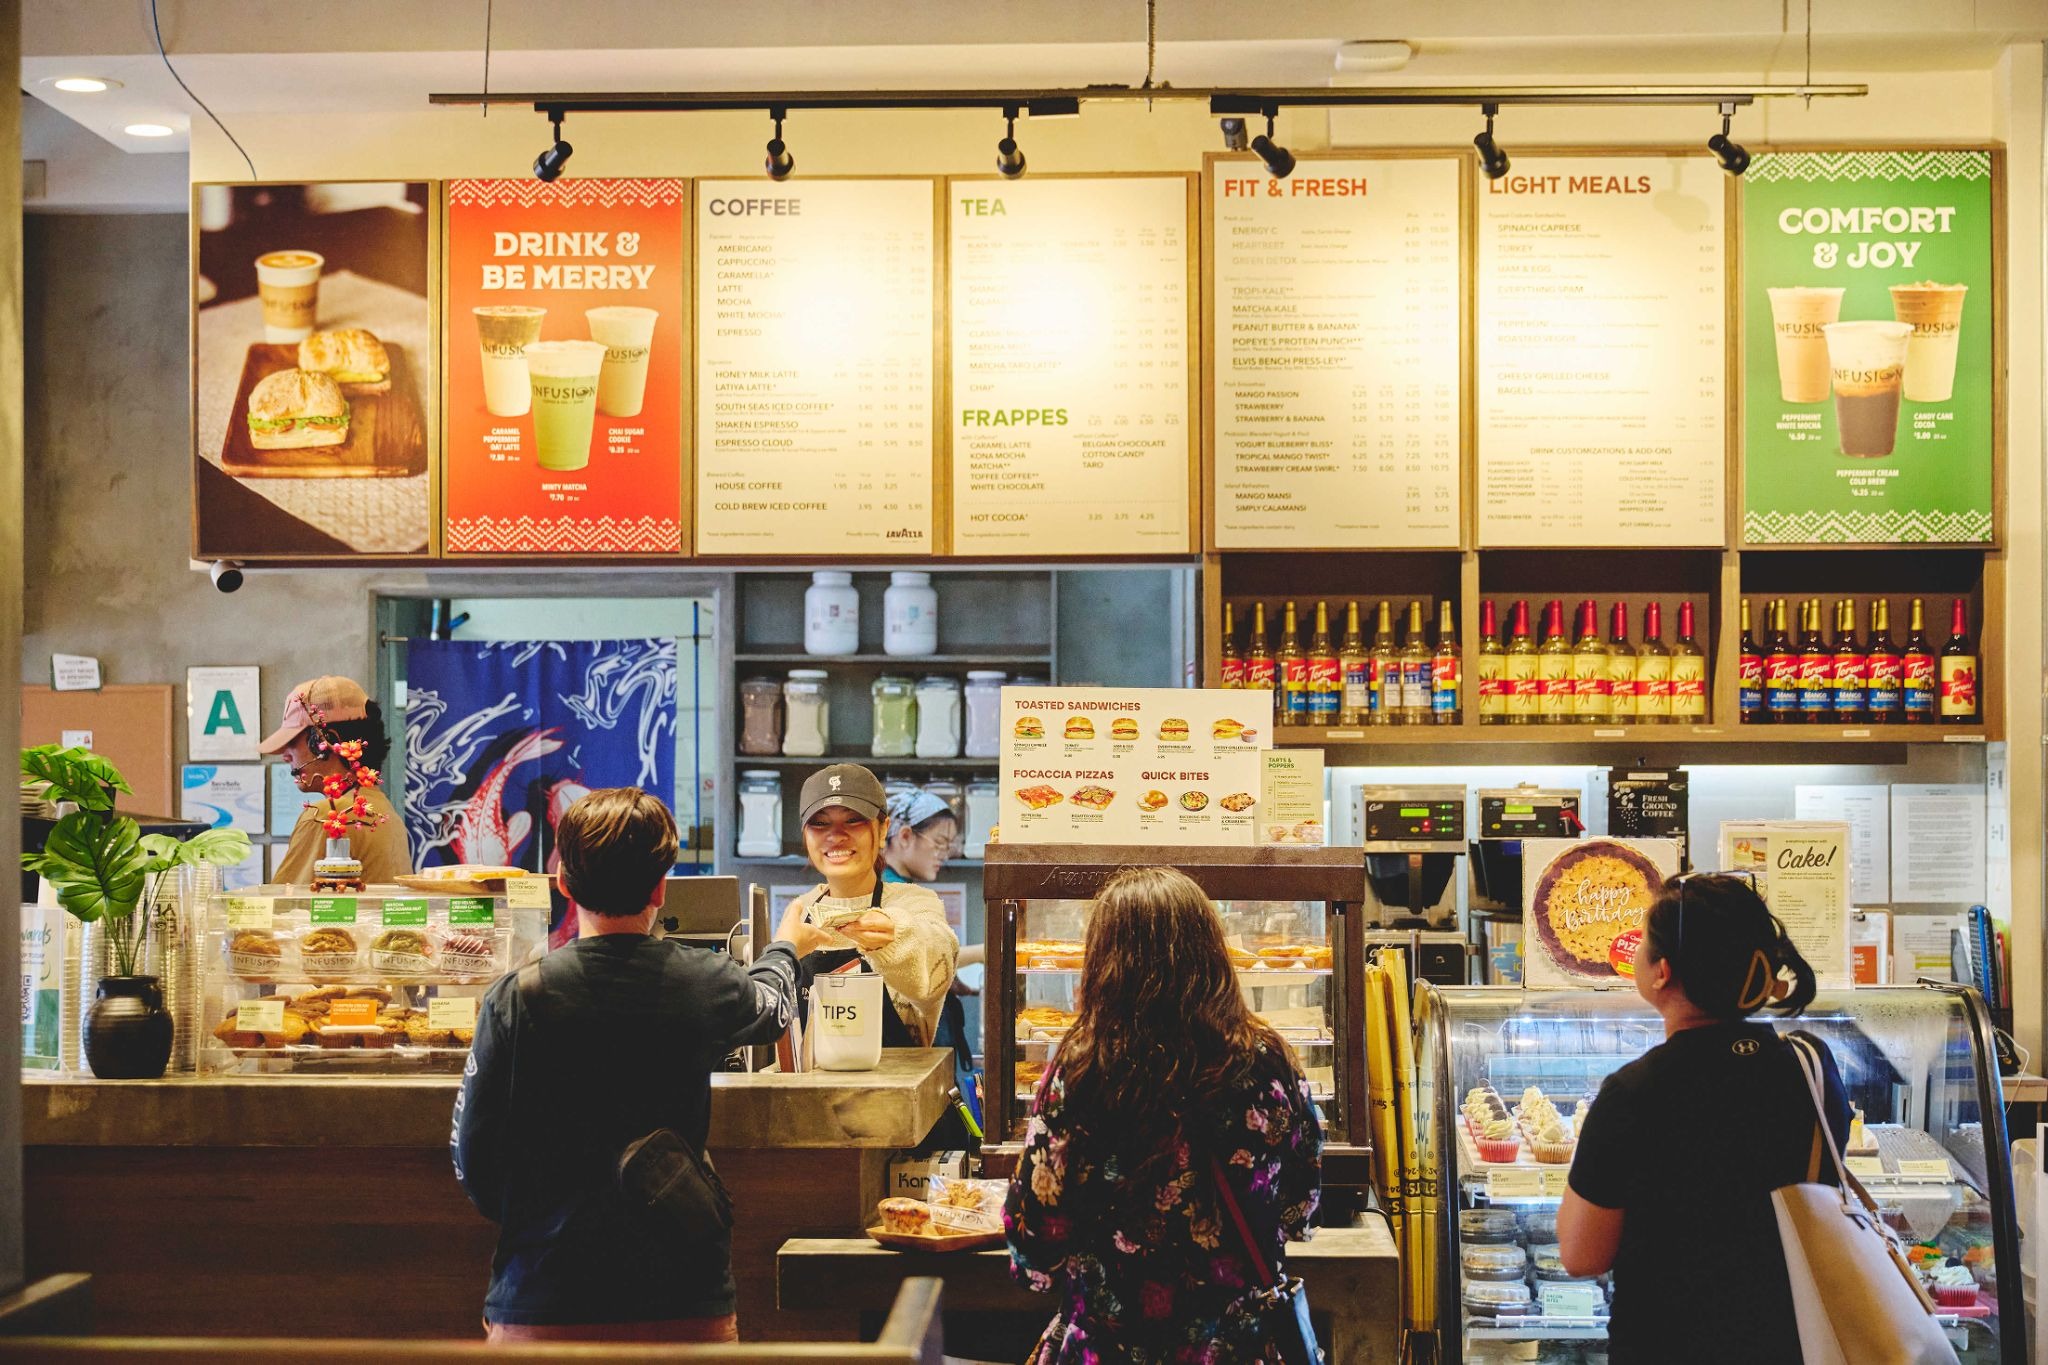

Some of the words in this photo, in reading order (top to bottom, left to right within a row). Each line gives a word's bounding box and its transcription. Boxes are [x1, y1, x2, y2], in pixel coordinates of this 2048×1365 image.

[1225, 179, 1260, 197] FIT
[1267, 179, 1282, 197] &
[1292, 178, 1367, 196] FRESH
[1489, 176, 1561, 194] LIGHT
[1569, 176, 1651, 194] MEALS
[709, 199, 801, 217] COFFEE
[961, 199, 1007, 217] TEA
[1778, 207, 1956, 234] COMFORT
[1232, 226, 1269, 235] ENERGY
[1271, 226, 1278, 235] C
[1498, 224, 1538, 233] SPINACH
[1540, 224, 1581, 233] CAPRESE
[494, 232, 608, 257] DRINK
[615, 232, 640, 257] &
[717, 244, 773, 253] AMERICANO
[1812, 242, 1839, 269] &
[1846, 241, 1921, 269] JOY
[717, 258, 776, 267] CAPPUCCINO
[1531, 265, 1551, 273] EGG
[481, 265, 526, 290] BE
[532, 265, 656, 290] MERRY
[717, 285, 743, 293] LATTE
[1498, 285, 1556, 294] EVERYTHING
[1558, 285, 1584, 294] SPAM
[717, 298, 752, 306] MOCHA
[1232, 305, 1297, 313] MATCHA-KALE
[717, 311, 746, 320] WHITE
[1232, 323, 1269, 332] PEANUT
[1271, 323, 1306, 332] BUTTER
[1308, 323, 1314, 332] &
[717, 328, 762, 337] ESPRESSO
[1232, 337, 1276, 346] POPEYE'S
[1278, 337, 1318, 346] PROTEIN
[1232, 357, 1257, 366] ELVIS
[1259, 357, 1290, 366] BENCH
[716, 371, 747, 379] HONEY
[749, 371, 771, 379] MILK
[773, 371, 799, 379] LATTE
[1498, 372, 1533, 381] CHEESY
[1535, 372, 1573, 381] GRILLED
[1575, 372, 1610, 381] CHEESE
[715, 384, 744, 392] LATIYA
[1498, 387, 1533, 395] BAGELS
[1235, 390, 1265, 398] MANGO
[1267, 390, 1300, 398] PASSION
[715, 403, 745, 411] SOUTH
[747, 403, 770, 411] SEAS
[772, 403, 793, 411] ICED
[1235, 403, 1284, 411] STRAWBERRY
[962, 408, 1069, 426] FRAPPES
[1235, 415, 1284, 423] STRAWBERRY
[1286, 415, 1292, 423] &
[1293, 415, 1325, 423] BANANA
[1913, 413, 1935, 421] CANDY
[1936, 413, 1953, 421] CANE
[715, 420, 752, 429] SHAKEN
[754, 420, 799, 429] ESPRESSO
[1776, 422, 1798, 430] WHITE
[1798, 422, 1822, 430] MOCHA
[1913, 421, 1936, 429] COCOA
[715, 438, 760, 447] ESPRESSO
[761, 438, 793, 447] CLOUD
[970, 441, 1007, 449] CARAMEL
[1009, 441, 1032, 449] LATTE
[1082, 440, 1116, 448] BELGIAN
[1117, 440, 1166, 448] CHOCOLATE
[1236, 440, 1265, 448] YOGURT
[1267, 440, 1308, 448] BLUEBERRY
[970, 451, 993, 459] KONA
[996, 451, 1026, 459] MOCHA
[1236, 452, 1271, 460] TROPICAL
[1273, 452, 1303, 460] MANGO
[1082, 461, 1104, 469] TARO
[1236, 465, 1284, 473] STRAWBERRY
[1286, 465, 1312, 473] CREAM
[970, 472, 999, 480] TOFFEE
[1836, 469, 1876, 477] PEPPERMINT
[1877, 469, 1899, 477] CREAM
[715, 482, 745, 490] HOUSE
[748, 482, 783, 490] COFFEE
[970, 483, 995, 491] WHITE
[997, 483, 1045, 491] CHOCOLATE
[1236, 492, 1265, 500] MANGO
[1267, 492, 1292, 500] MANSI
[715, 503, 740, 511] COLD
[742, 503, 768, 511] BREW
[770, 503, 791, 511] ICED
[793, 503, 828, 511] COFFEE
[1236, 504, 1261, 513] SIMPLY
[1263, 504, 1307, 513] CALAMANSI
[970, 513, 989, 522] HOT
[1307, 665, 1338, 682] Torani
[1799, 661, 1830, 679] Torani
[1834, 661, 1865, 679] Torani
[1949, 682, 1972, 695] Torani
[1015, 700, 1065, 711] TOASTED
[1067, 701, 1141, 711] SANDWICHES
[204, 690, 246, 735] A
[1013, 769, 1072, 780] FOCACCIA
[1075, 770, 1115, 780] PIZZAS
[1141, 771, 1177, 781] QUICK
[1179, 772, 1210, 781] BITES
[1642, 794, 1668, 802] FRESH
[1642, 802, 1677, 810] GROUND
[1642, 810, 1674, 818] COFFEE
[1777, 845, 1837, 870] Cake!
[1576, 879, 1636, 911] happy
[1561, 901, 1648, 933] Birthday
[822, 1004, 857, 1021] TIPS
[932, 1208, 984, 1225] INFUSION
